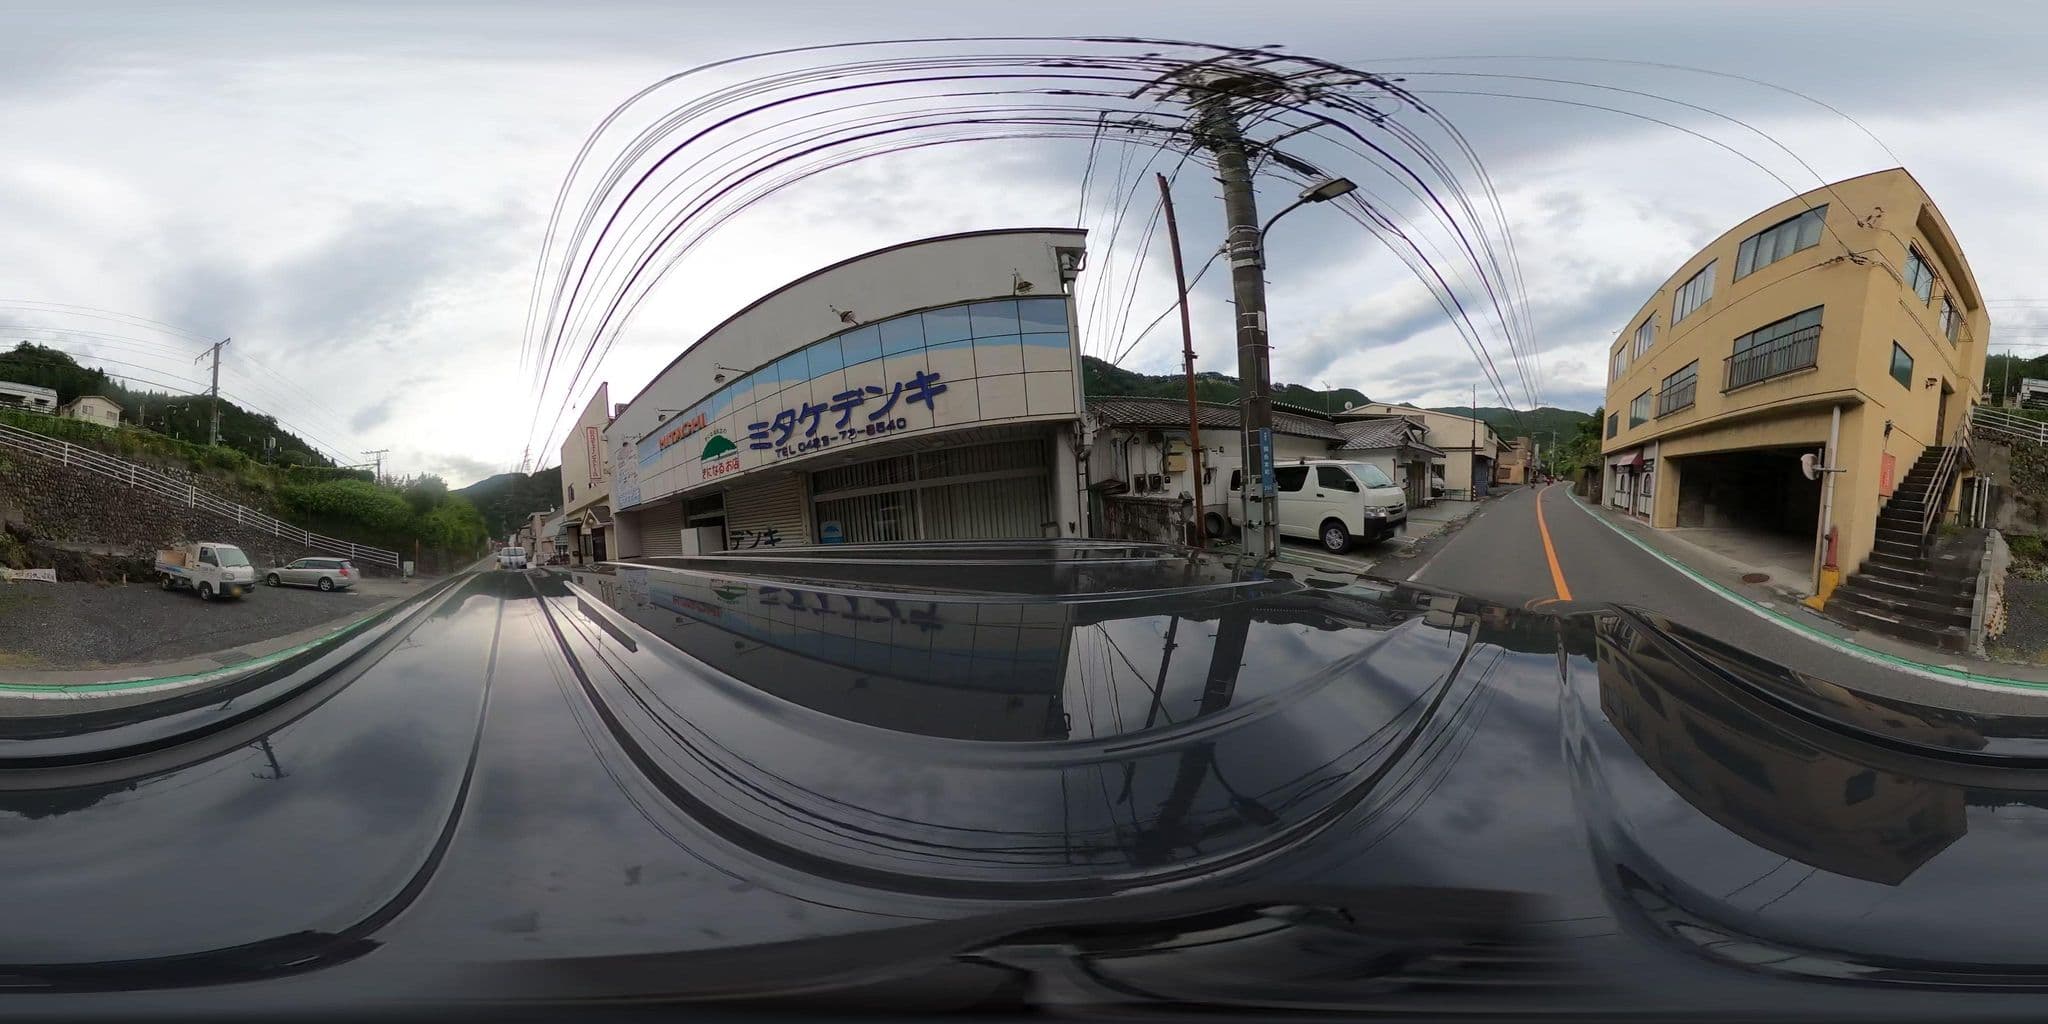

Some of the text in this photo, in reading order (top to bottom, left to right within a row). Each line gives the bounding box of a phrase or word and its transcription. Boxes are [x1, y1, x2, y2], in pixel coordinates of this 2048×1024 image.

[748, 371, 947, 449] ミタケデンキ
[775, 444, 796, 458] TEL
